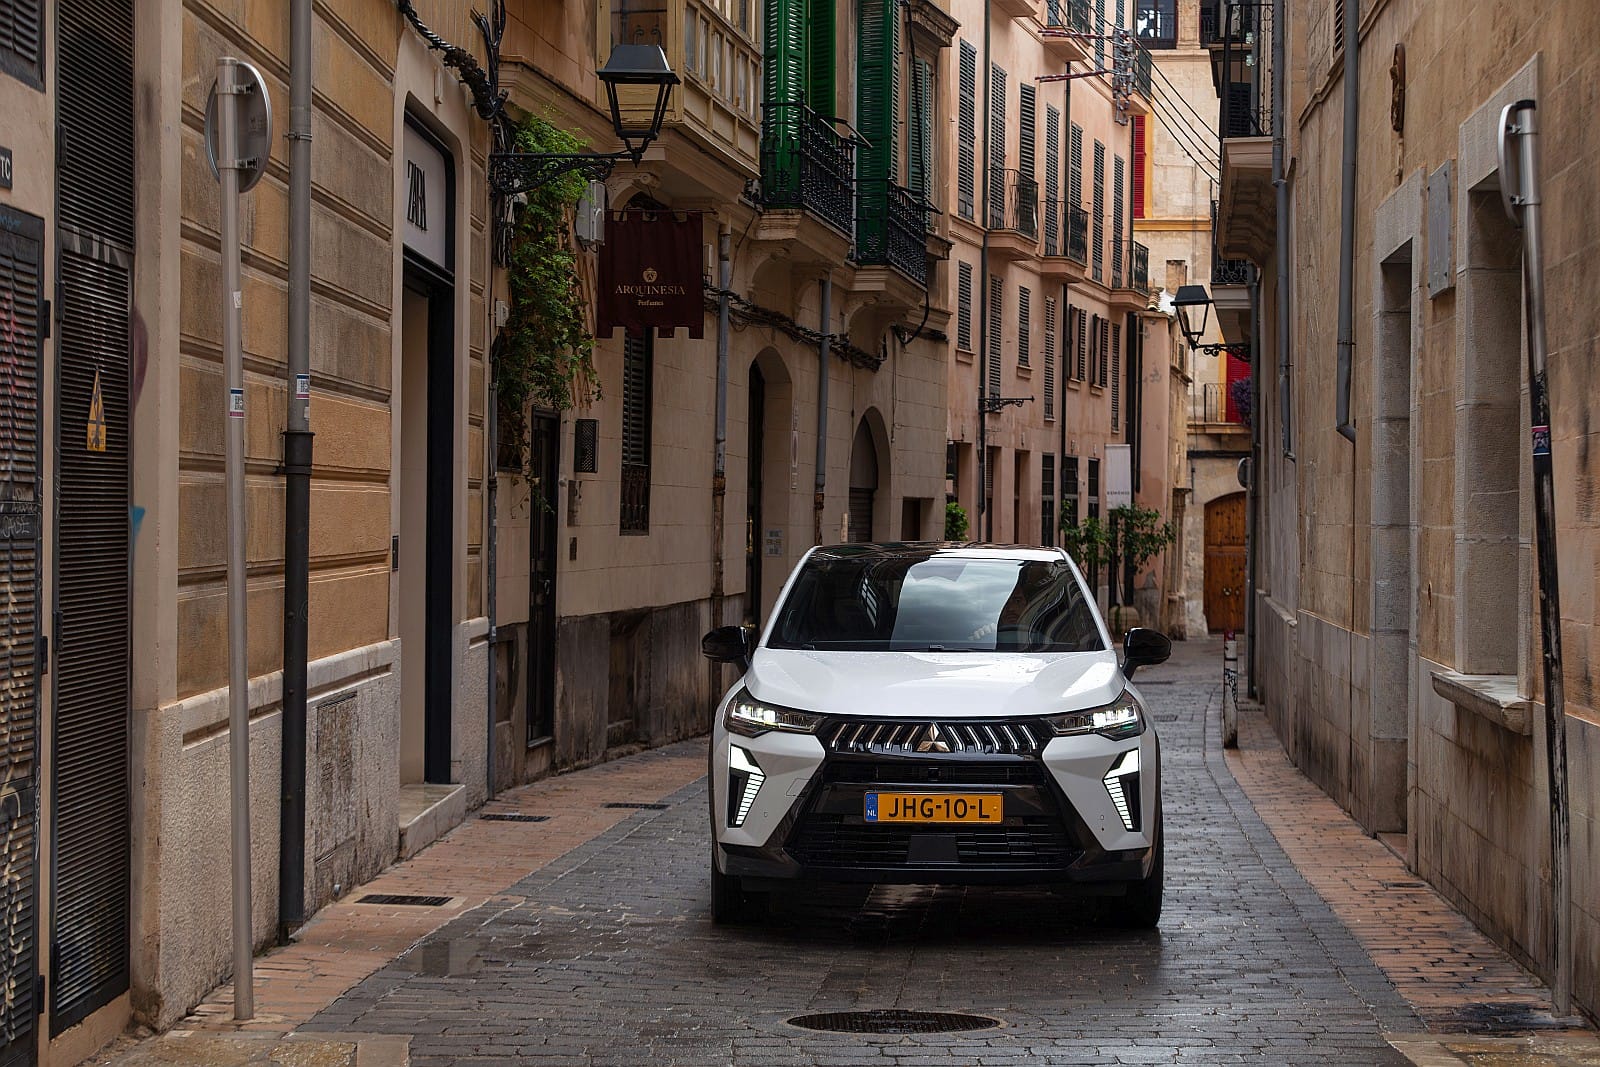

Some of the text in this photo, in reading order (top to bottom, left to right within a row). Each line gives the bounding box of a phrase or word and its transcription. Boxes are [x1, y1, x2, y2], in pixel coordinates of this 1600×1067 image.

[407, 160, 427, 231] ZARA
[615, 284, 685, 297] ARQUINESIA
[867, 809, 877, 817] NL
[888, 797, 990, 819] JHG-10-L
